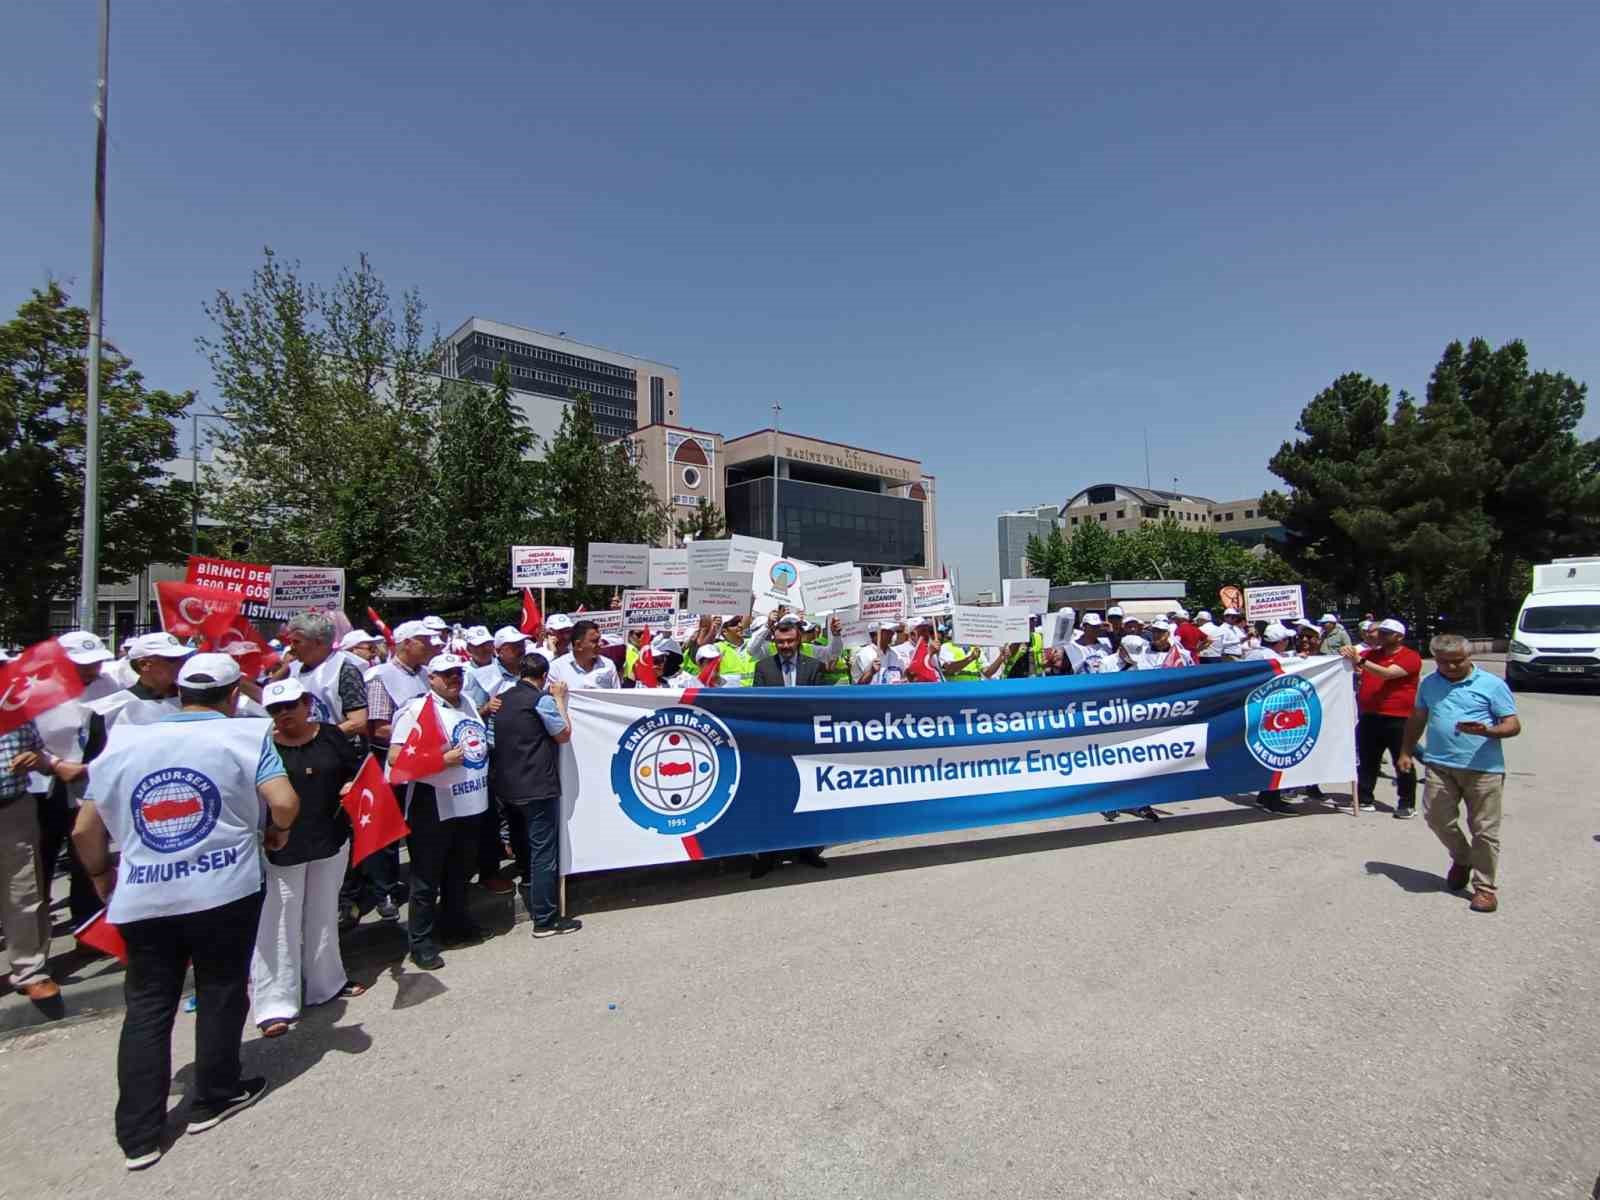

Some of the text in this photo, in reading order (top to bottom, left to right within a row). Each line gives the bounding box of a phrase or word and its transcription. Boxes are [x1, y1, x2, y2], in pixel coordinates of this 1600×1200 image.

[197, 563, 245, 580] BİRİNCİ
[227, 584, 242, 595] EK
[624, 713, 724, 752] ENERJİ BİR-SEN
[812, 697, 1200, 745] Emekten Tasarruf Edilemez
[814, 740, 1196, 793] Kazanımlarımız Engellenemez
[126, 847, 237, 885] MEMUR-SEN
